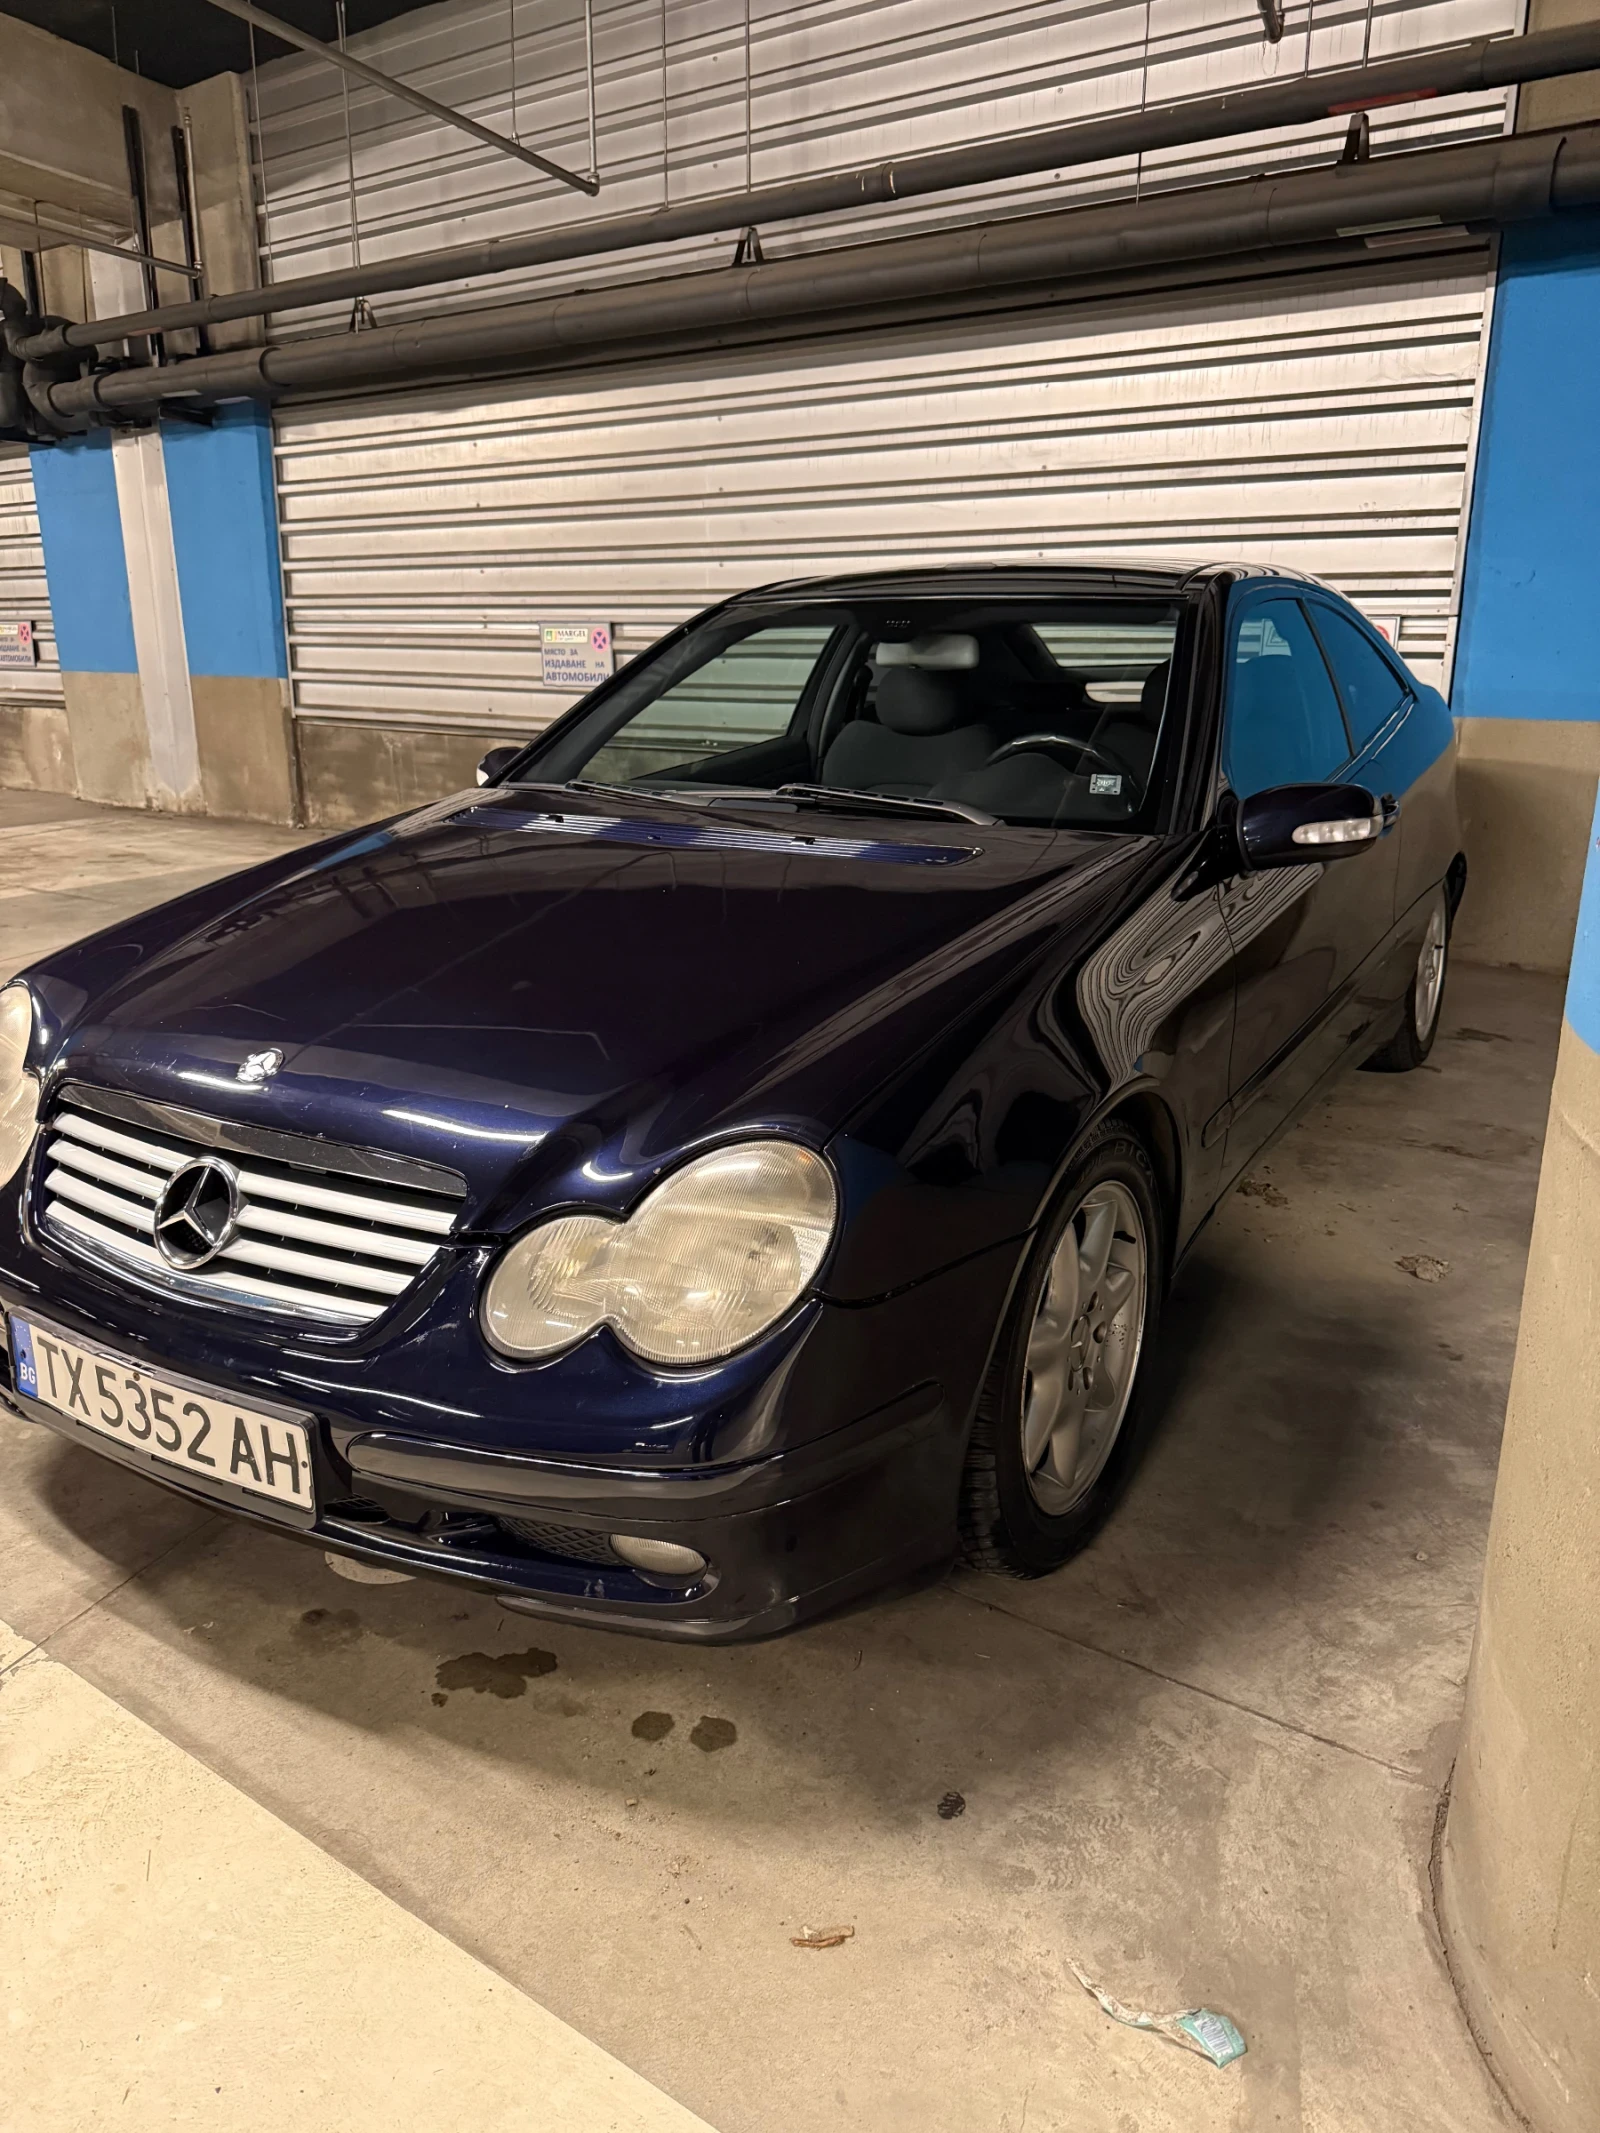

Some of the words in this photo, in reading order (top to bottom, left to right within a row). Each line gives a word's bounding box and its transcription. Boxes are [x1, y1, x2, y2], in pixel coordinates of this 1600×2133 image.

[570, 648, 578, 656] ЗА
[544, 659, 586, 669] ИЗДАВАНЕ
[20, 1362, 36, 1385] BG
[37, 1336, 91, 1416] TX
[95, 1365, 216, 1468] 5352
[230, 1417, 302, 1494] AH
